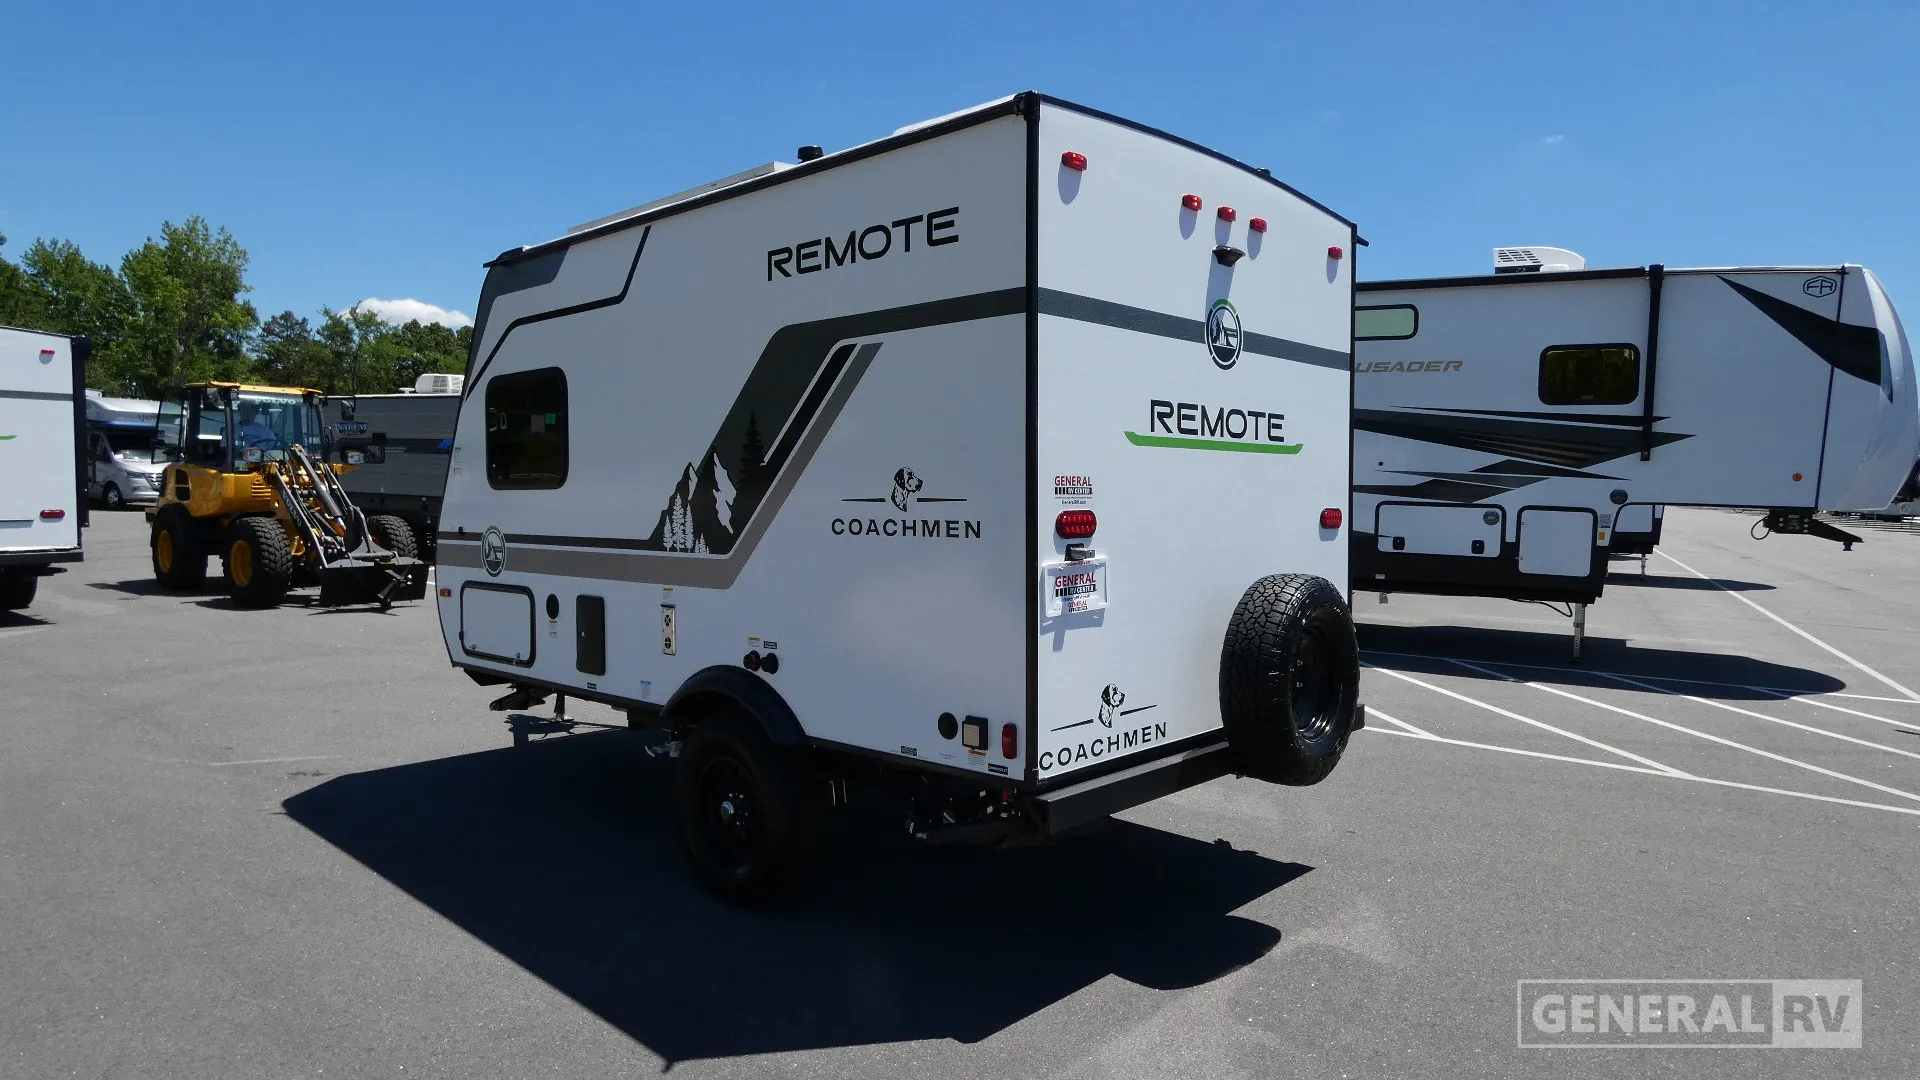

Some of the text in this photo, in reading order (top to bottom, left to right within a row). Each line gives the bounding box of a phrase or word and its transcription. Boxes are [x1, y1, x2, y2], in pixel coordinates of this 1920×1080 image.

[767, 206, 959, 282] REMOTE
[1355, 360, 1463, 373] USADER
[1150, 398, 1285, 442] REMOTE
[1054, 475, 1093, 487] GENERAL
[831, 518, 981, 539] COACHMEN
[1055, 571, 1097, 588] GENERAL
[1076, 584, 1095, 594] CENTER
[1038, 721, 1167, 771] COACHMEN
